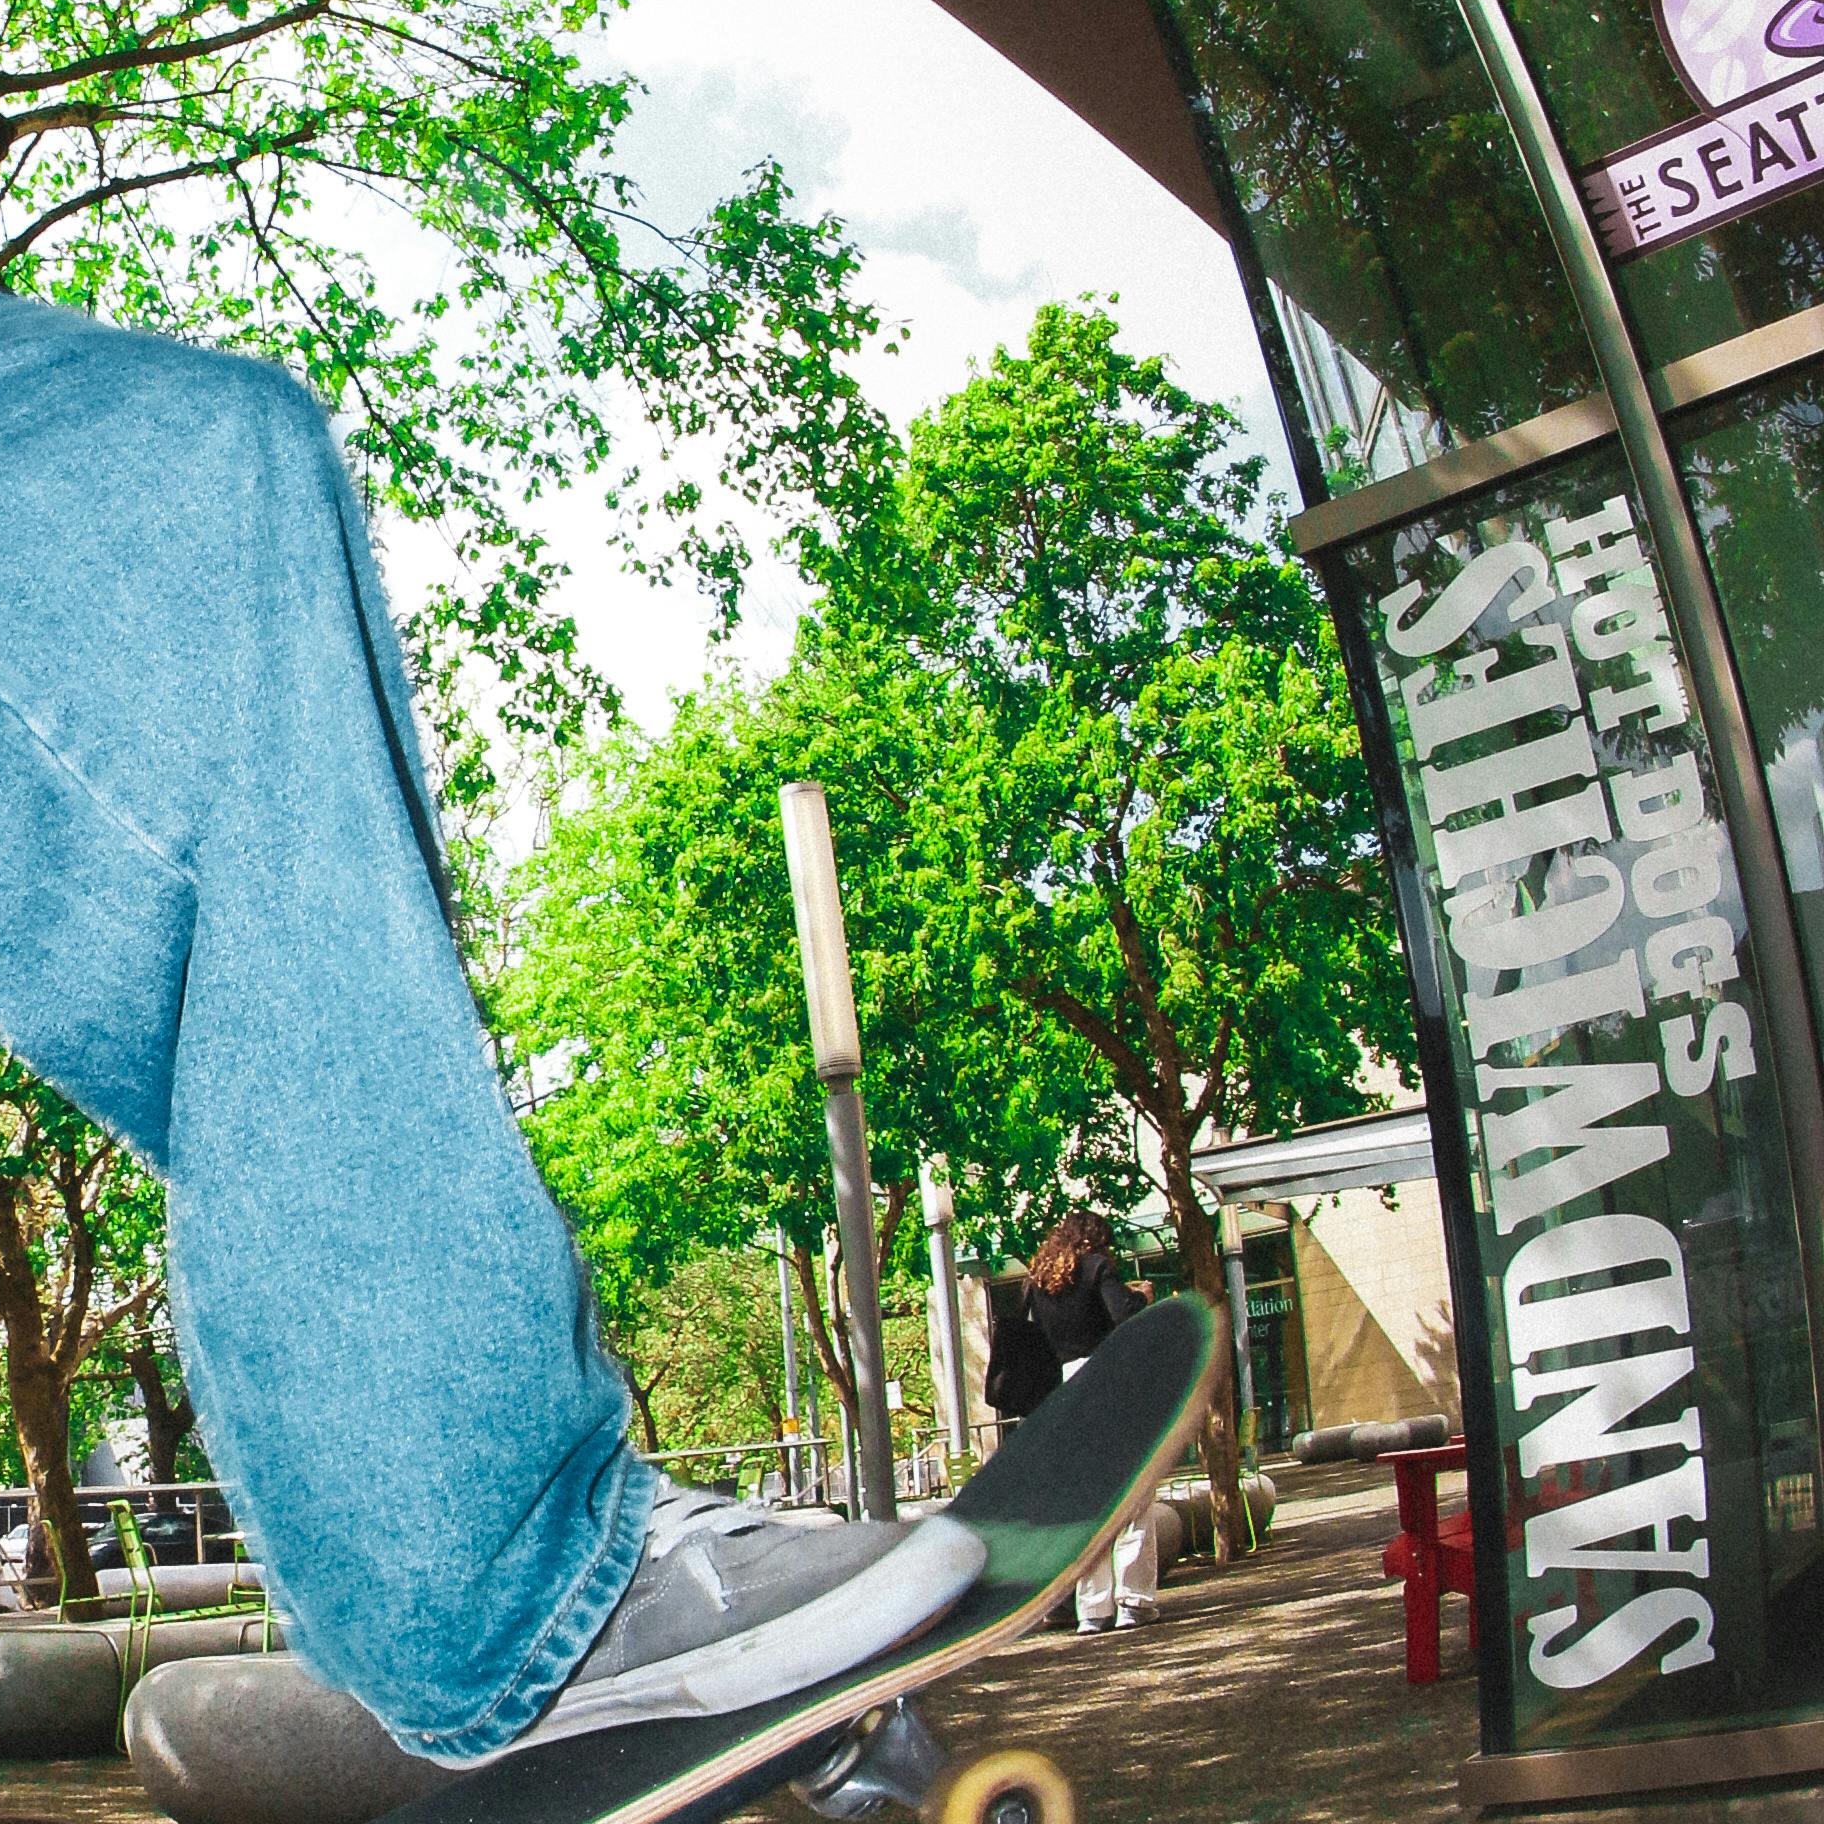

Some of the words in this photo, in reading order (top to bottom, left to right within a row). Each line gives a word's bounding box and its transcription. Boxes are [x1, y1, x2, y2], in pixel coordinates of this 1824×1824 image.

[1619, 174, 1663, 242] THE
[1657, 93, 1824, 219] SEAT
[1544, 494, 1688, 734] HOT
[1608, 750, 1757, 1097] DOGS
[1378, 541, 1716, 1689] SANDWICHES
[1245, 1298, 1293, 1316] dation
